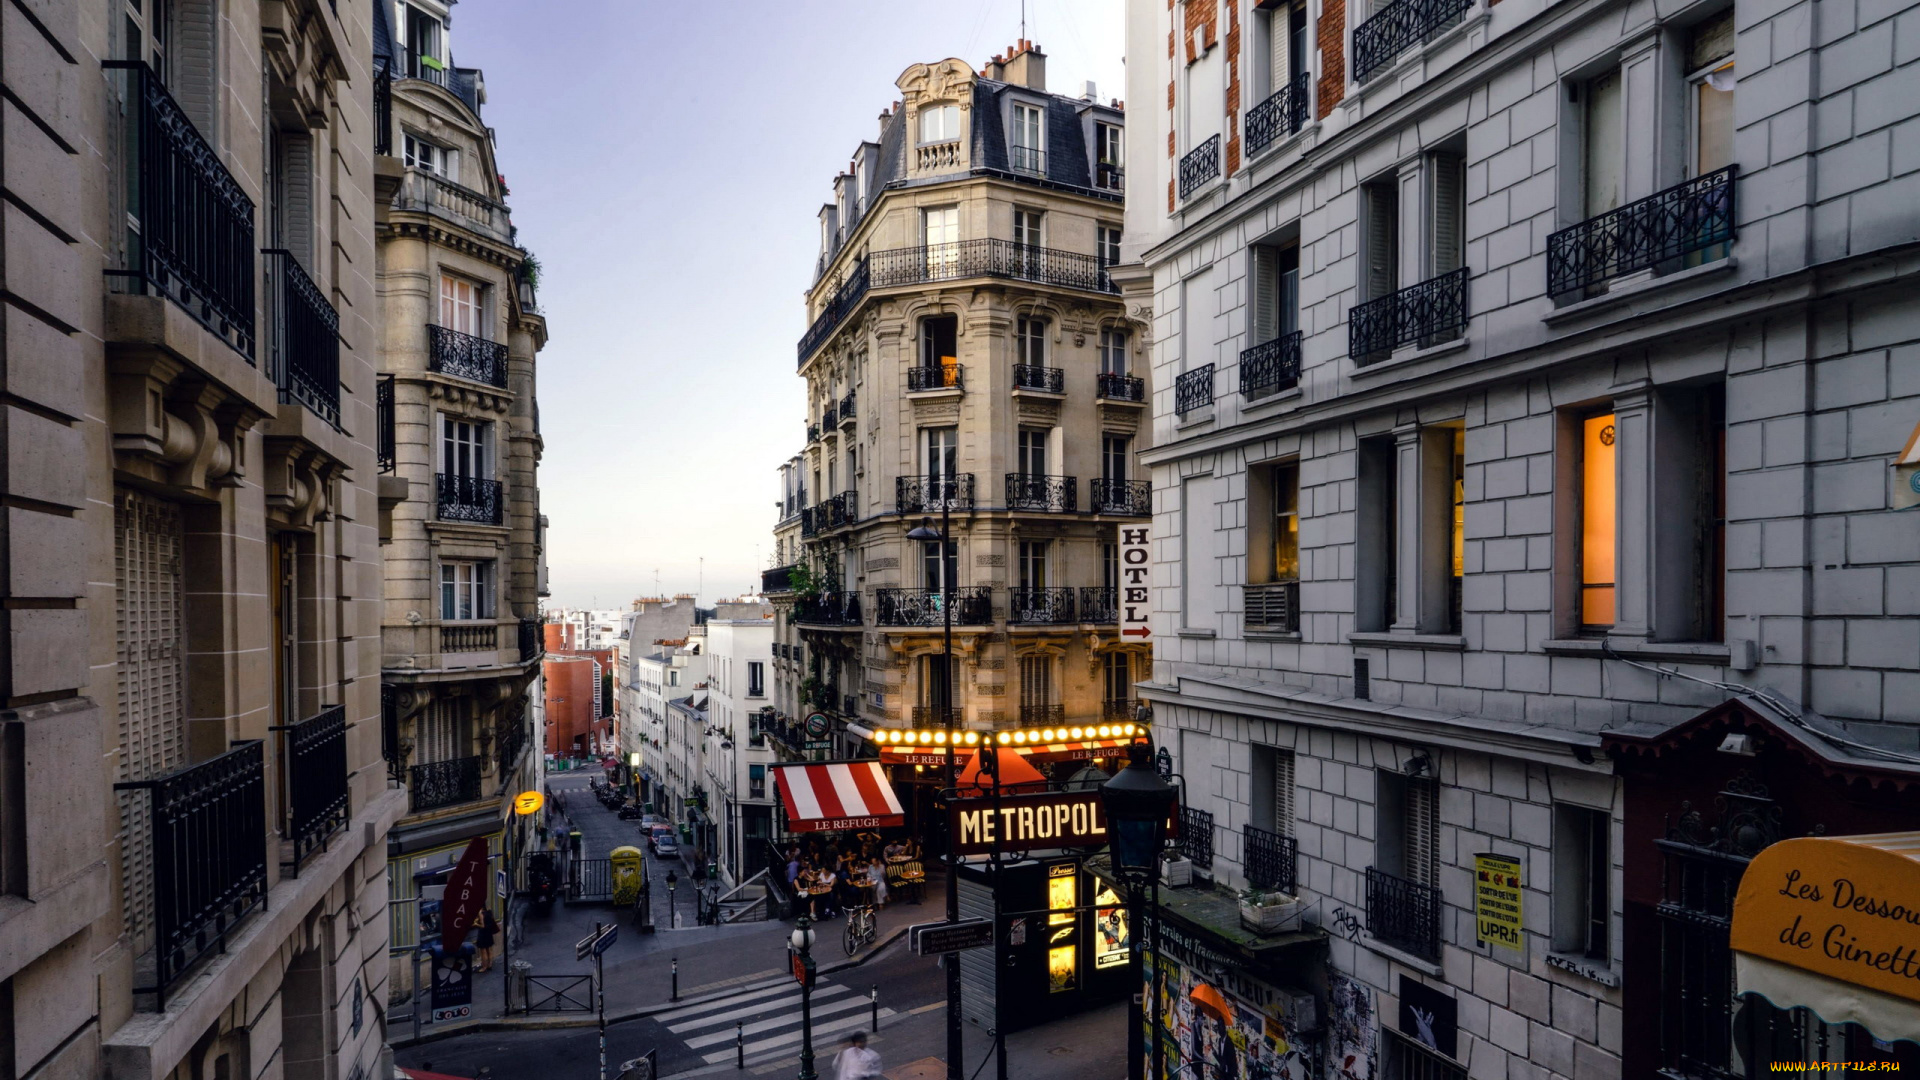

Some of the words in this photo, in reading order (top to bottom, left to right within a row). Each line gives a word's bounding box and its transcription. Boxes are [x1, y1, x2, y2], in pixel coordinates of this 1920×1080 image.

[1122, 528, 1149, 622] HOTEL
[905, 755, 919, 764] LE
[920, 755, 963, 765] REFUE
[1072, 751, 1084, 760] LE
[814, 821, 830, 831] LE
[833, 817, 880, 830] REFUGE
[960, 802, 1171, 845] METROPOL
[1779, 869, 1824, 902] Les
[454, 861, 479, 929] TABAC
[1479, 886, 1498, 897] SORTIR
[1498, 890, 1506, 900] DE
[1506, 892, 1518, 902] L'UE
[1479, 897, 1495, 907] SORTIR
[1495, 901, 1503, 909] DE
[1503, 903, 1518, 913] L'EURO
[1480, 908, 1495, 918] SORTIR
[1495, 911, 1502, 920] DE
[1502, 913, 1518, 924] L'OTAN
[1480, 920, 1518, 944] UPR.fr
[1779, 915, 1813, 949] de
[435, 1007, 470, 1020] LOTO
